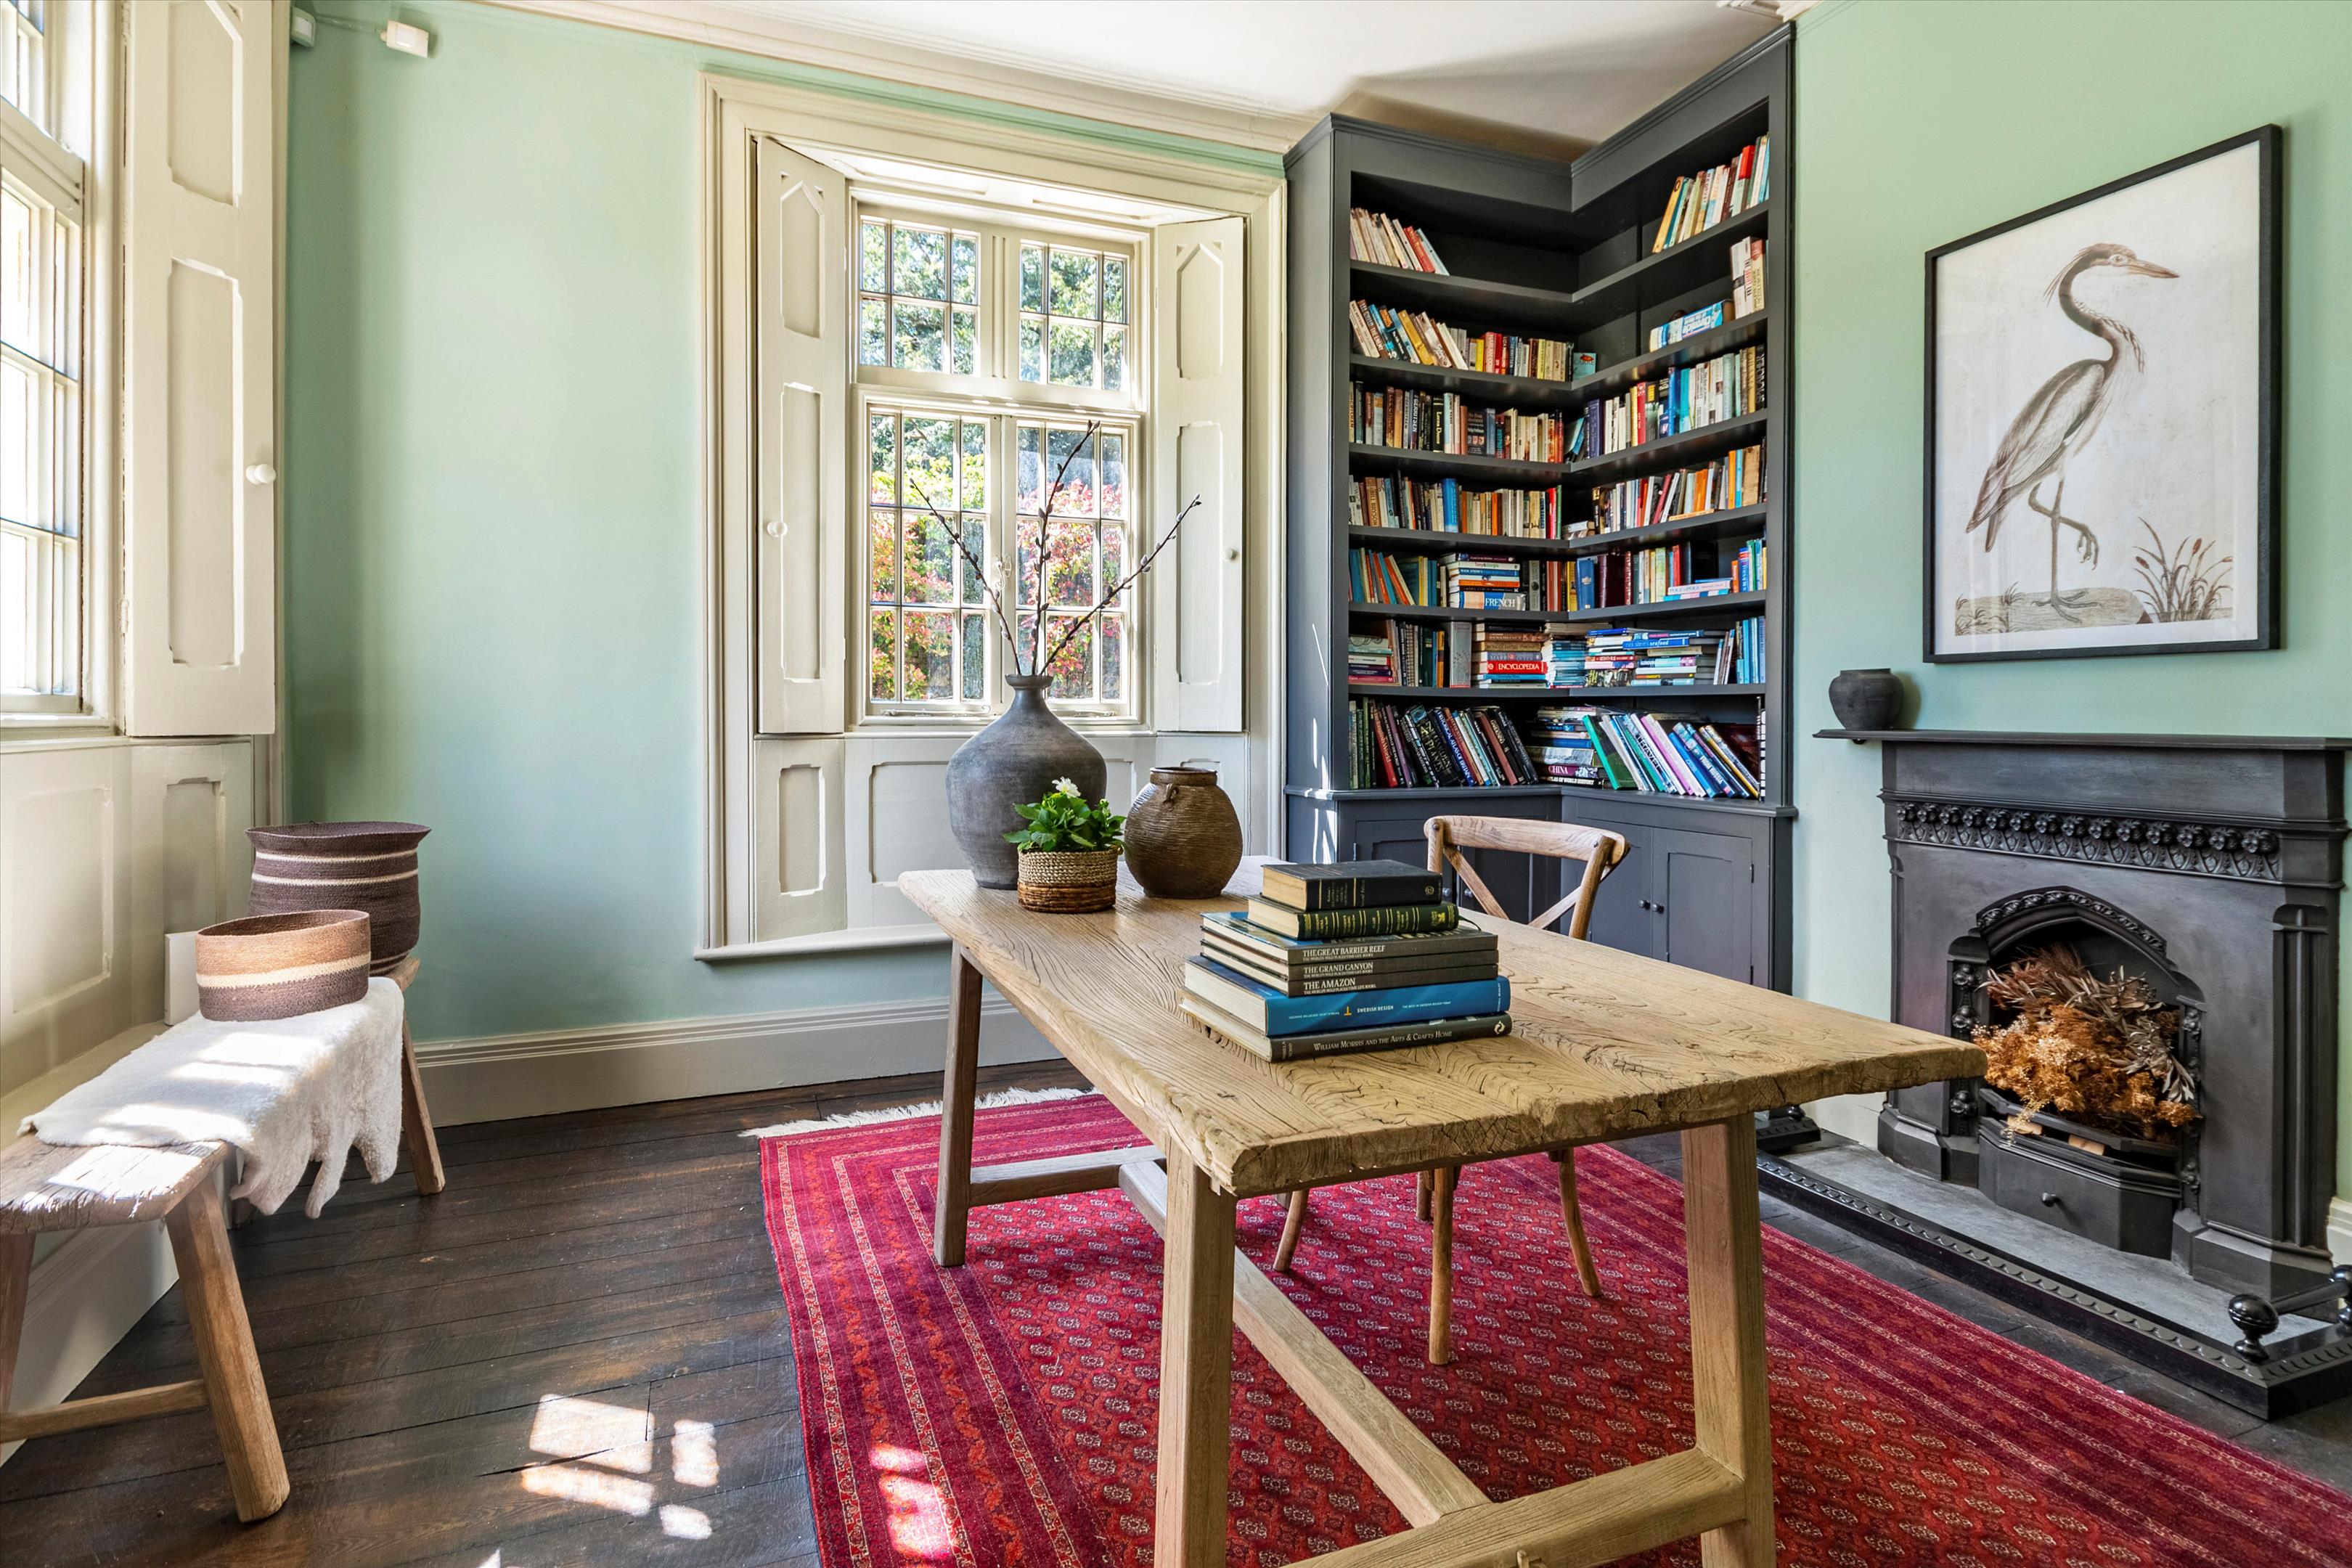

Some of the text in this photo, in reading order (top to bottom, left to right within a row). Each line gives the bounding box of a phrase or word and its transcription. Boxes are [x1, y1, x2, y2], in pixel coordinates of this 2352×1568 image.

[1485, 598, 1515, 607] FRENCH
[1340, 946, 1368, 955] BARRIER
[1304, 978, 1356, 990] THE AMAZON
[1314, 1042, 1340, 1051] WILLIAM
[1340, 1040, 1364, 1048] MORRIS
[1413, 1032, 1434, 1041] CRAFTS
